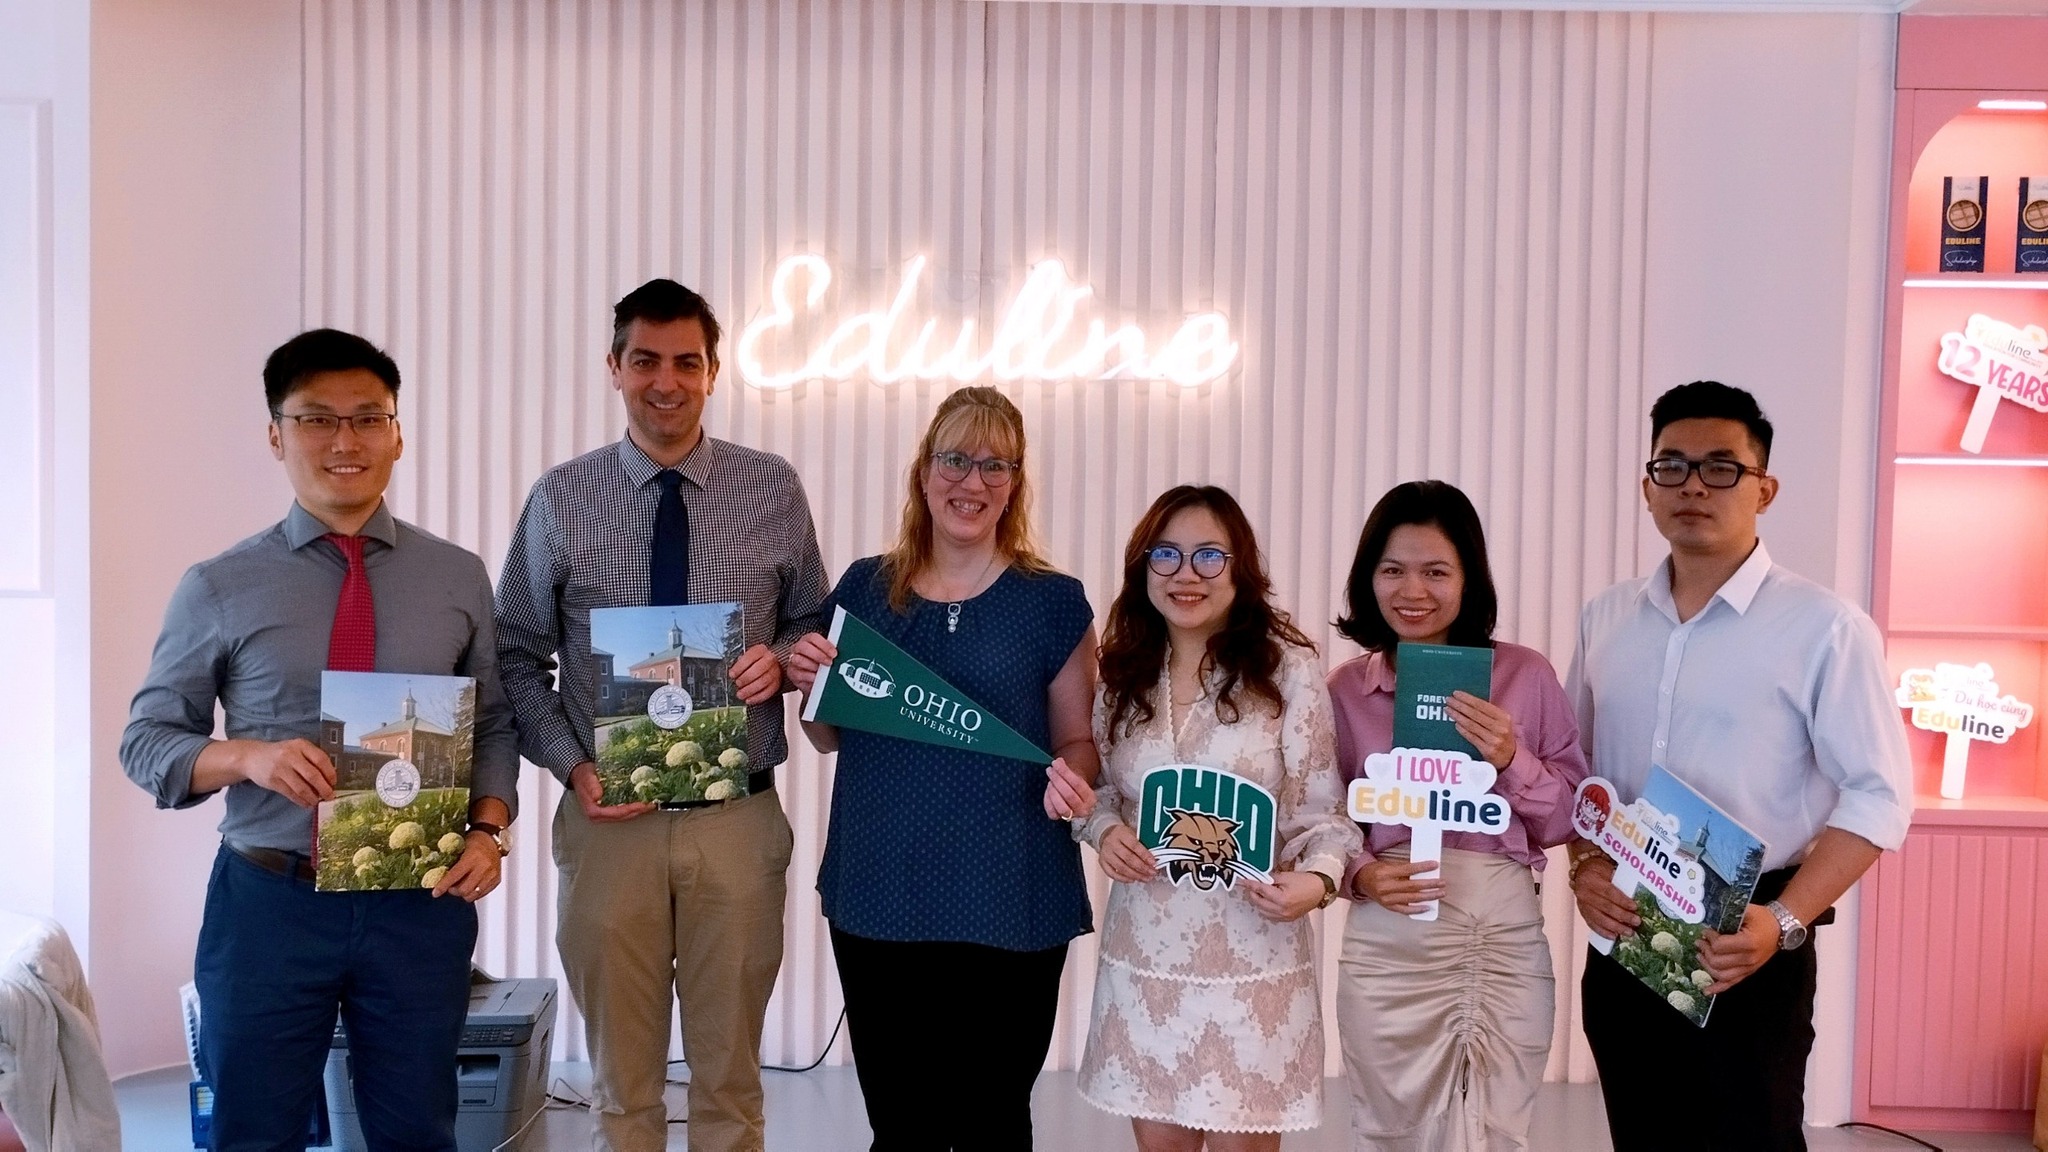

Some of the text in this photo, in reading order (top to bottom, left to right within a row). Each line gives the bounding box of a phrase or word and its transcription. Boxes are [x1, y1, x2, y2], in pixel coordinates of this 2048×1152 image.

[1945, 237, 1981, 246] EDULINE
[2021, 237, 2048, 246] EDULI
[737, 254, 1240, 387] Eduline
[1945, 339, 1981, 378] 12
[1987, 359, 2048, 406] YEARS
[852, 681, 877, 696] 1804
[1417, 694, 1446, 704] FOREV
[1955, 690, 2028, 721] Du học cùng
[904, 684, 982, 731] OHIO
[1416, 705, 1455, 722] OHI
[1917, 708, 2004, 738] Eduline
[900, 706, 974, 744] UNIVERSITY
[1396, 755, 1462, 785] I LOVE
[1139, 768, 1273, 872] OHIO
[1355, 786, 1502, 826] Eduline
[1611, 810, 1681, 879] Eduline
[1603, 832, 1697, 915] SCHOLARSHIP
